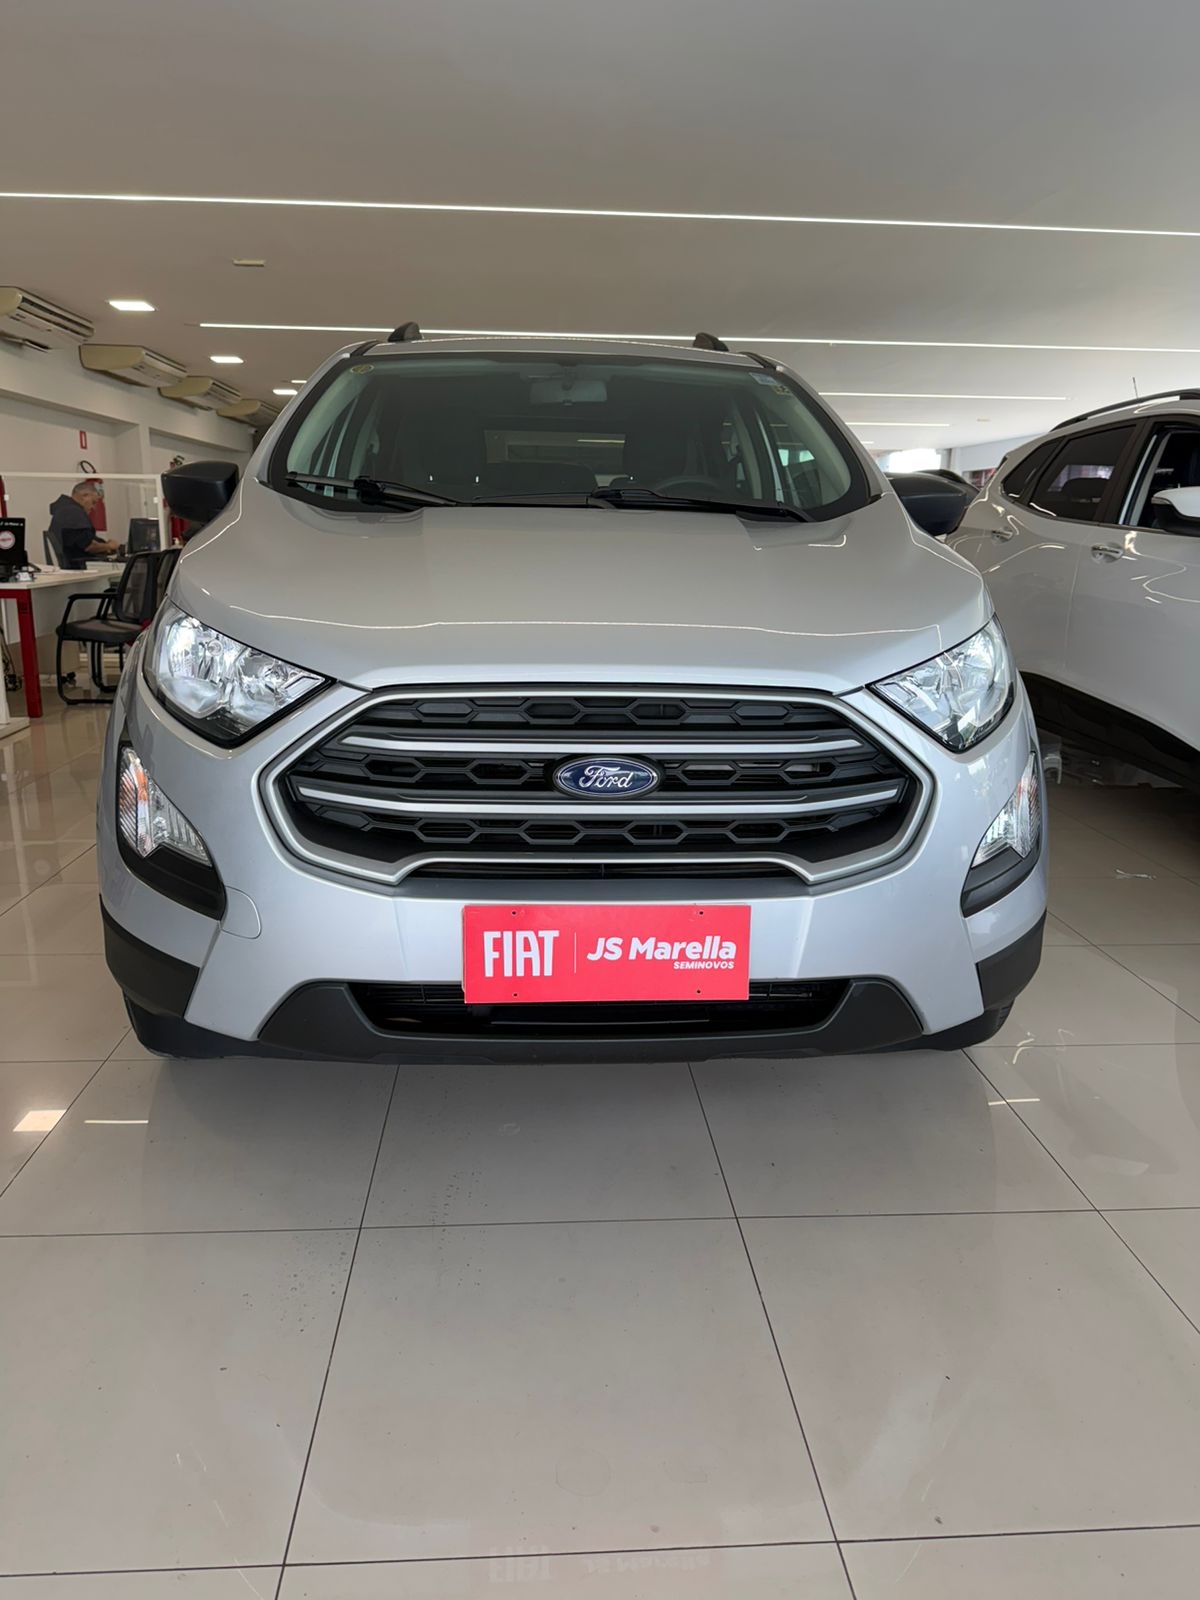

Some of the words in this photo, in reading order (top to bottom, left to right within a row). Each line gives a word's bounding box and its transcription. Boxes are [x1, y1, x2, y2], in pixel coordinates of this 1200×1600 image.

[578, 765, 633, 788] Ford
[483, 930, 560, 977] FIAT
[586, 937, 624, 961] JS
[628, 935, 737, 961] Marella
[673, 960, 735, 970] SEMINOVOS
